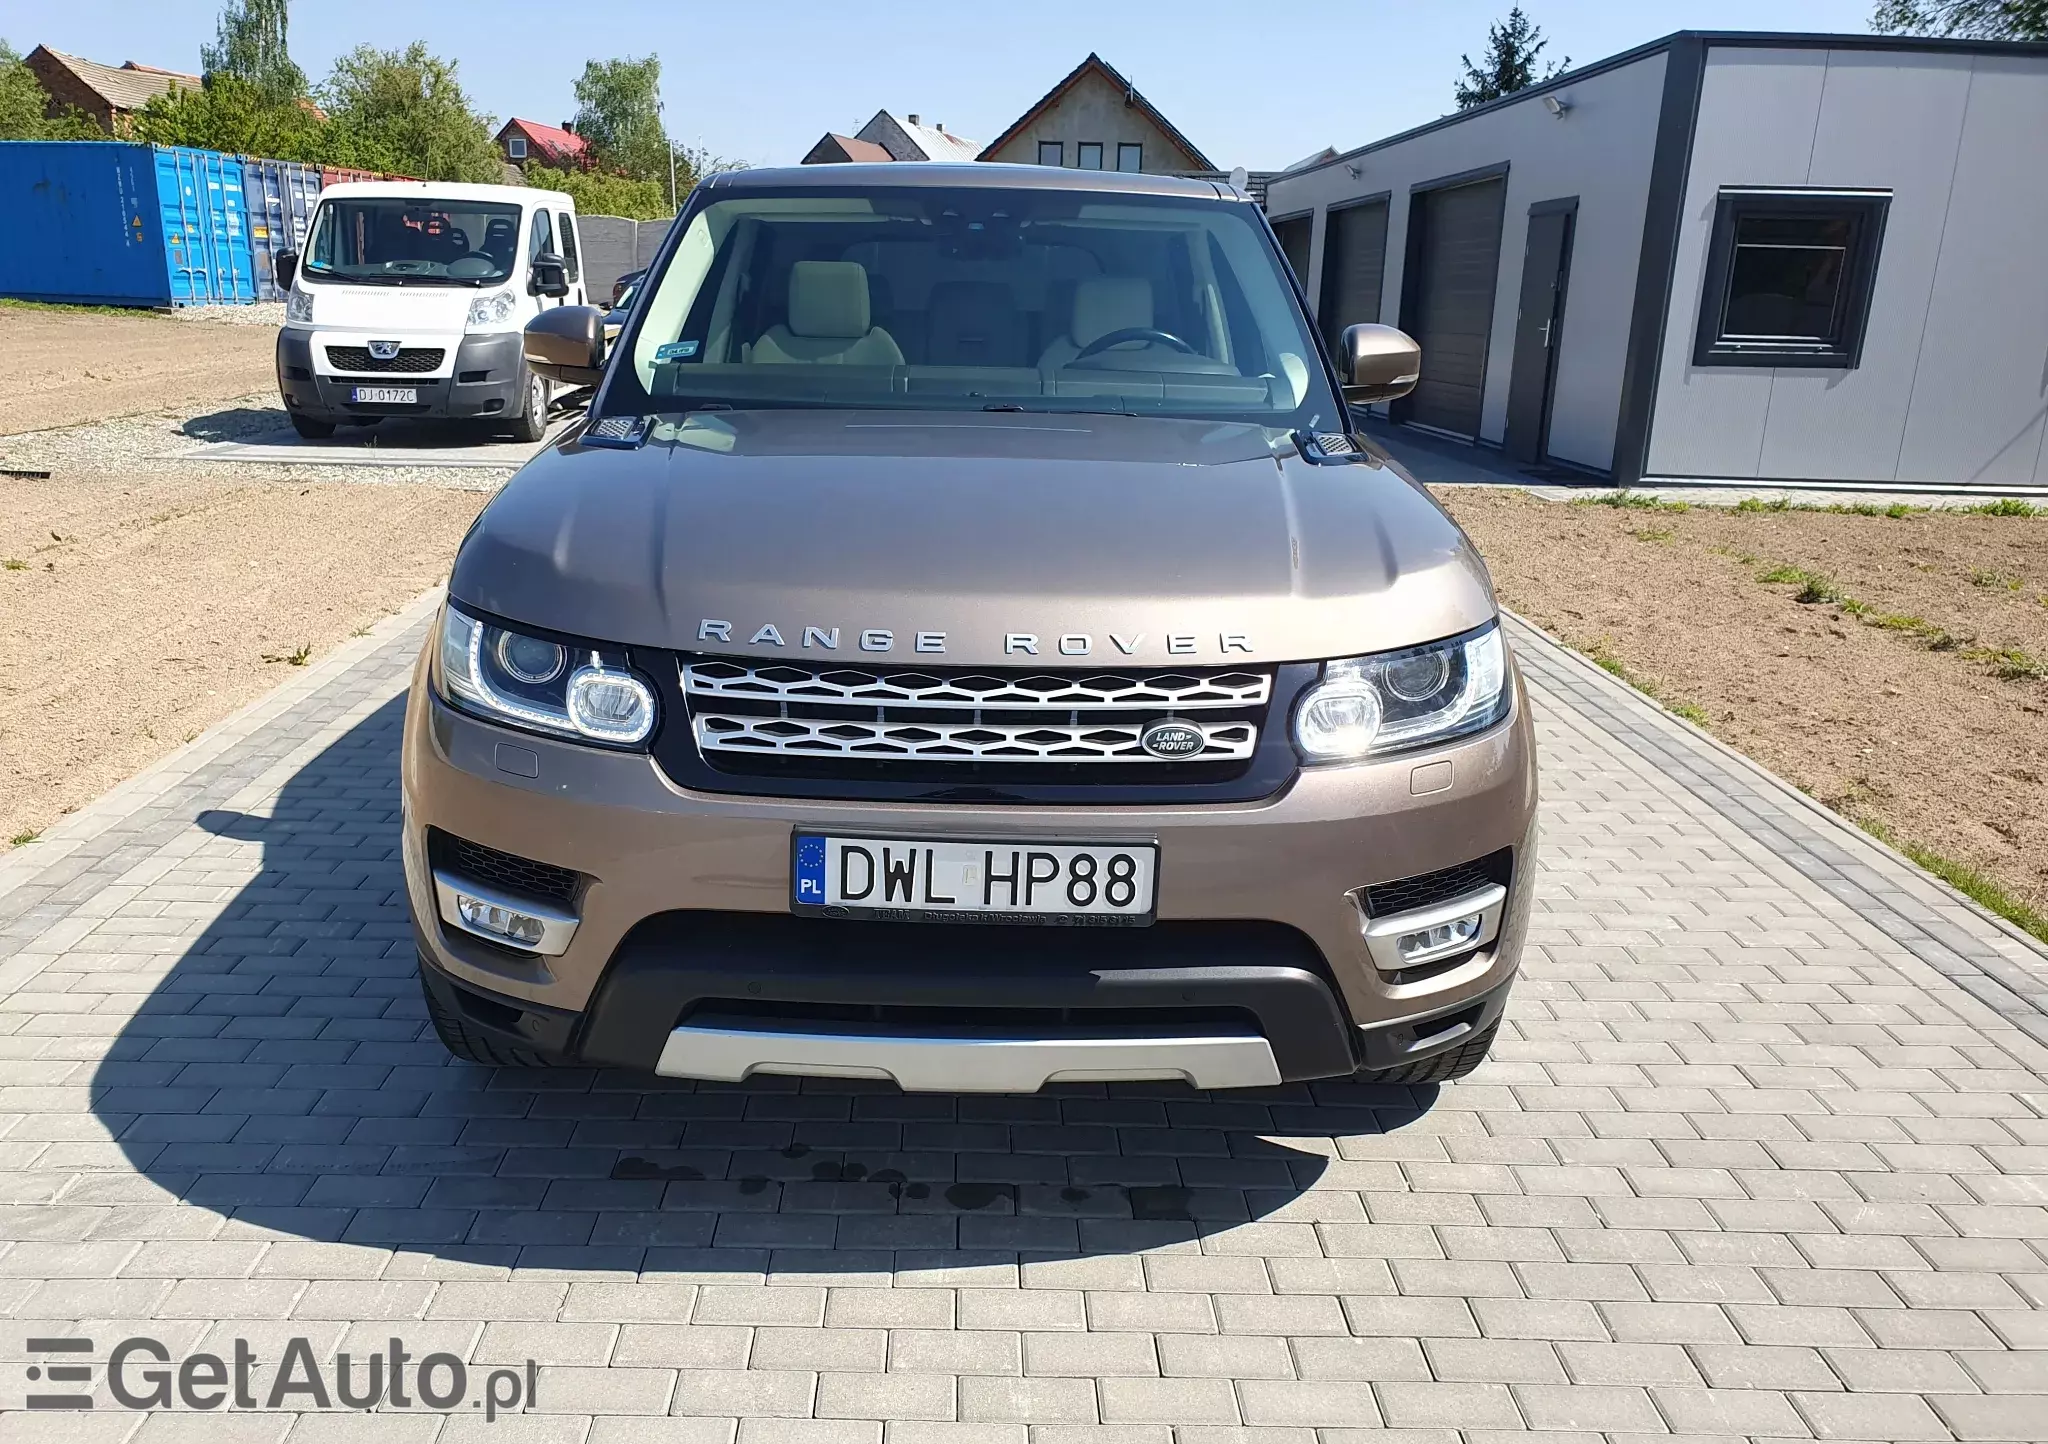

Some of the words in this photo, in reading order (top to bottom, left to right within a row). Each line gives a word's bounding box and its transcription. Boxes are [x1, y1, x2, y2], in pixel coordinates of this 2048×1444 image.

[359, 389, 373, 400] DJ
[378, 389, 414, 402] 0172C
[698, 619, 947, 652] RANGE
[1004, 632, 1254, 655] ROVER
[1156, 732, 1185, 741] LAND
[1158, 741, 1194, 751] ROVER
[840, 845, 957, 904] DWL
[983, 850, 1137, 908] HP88
[800, 879, 821, 894] PL
